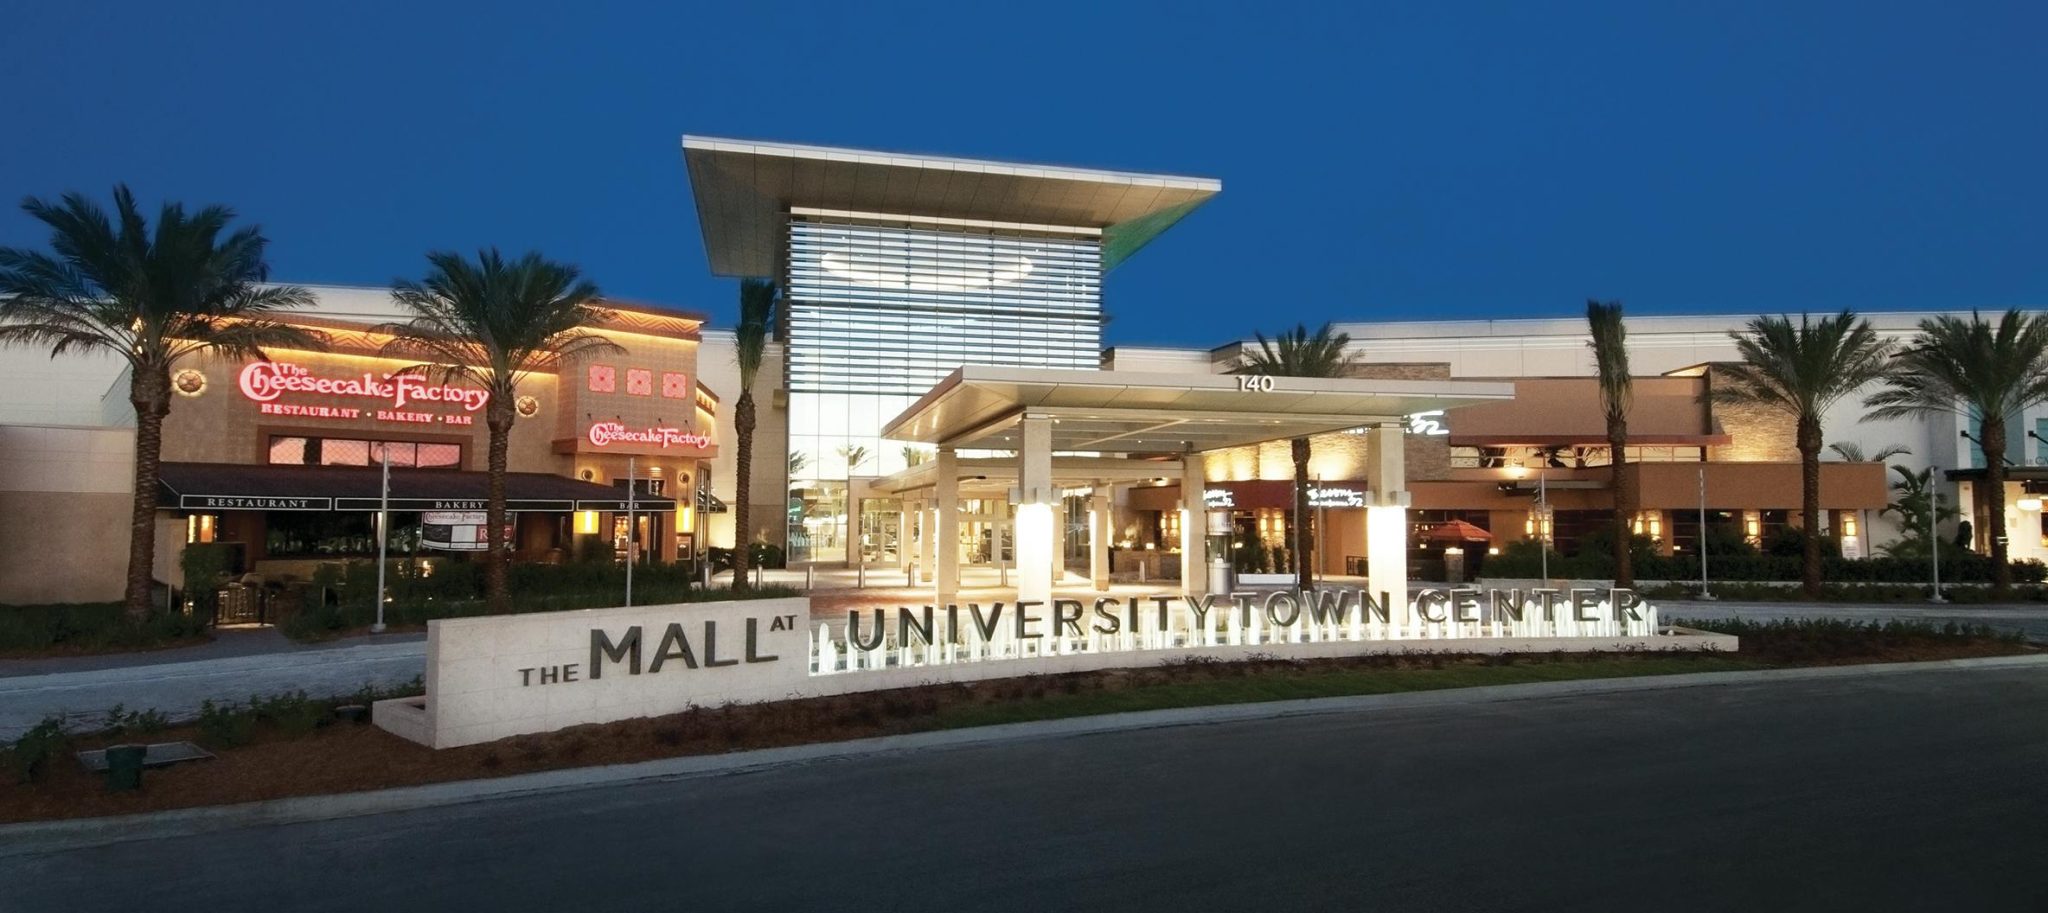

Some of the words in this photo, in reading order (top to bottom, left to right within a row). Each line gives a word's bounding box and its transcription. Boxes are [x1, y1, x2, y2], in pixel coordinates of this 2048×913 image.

[280, 362, 308, 376] The
[239, 361, 394, 401] Cheesecake
[385, 374, 489, 411] Factory
[1238, 375, 1275, 393] 140
[261, 403, 360, 418] RESTAURANT
[377, 410, 433, 423] BAKERY
[446, 414, 473, 425] BAR
[589, 423, 662, 446] Cheesecake
[657, 428, 711, 449] Factory
[208, 498, 308, 509] RESTAURANT
[435, 501, 484, 509] BAKERY
[848, 596, 1216, 652] UNIVERSITY
[1231, 589, 1391, 628] TOWN
[1416, 587, 1643, 623] CENTER
[518, 663, 579, 687] THE
[589, 617, 779, 680] MALL
[769, 614, 798, 632] AT
